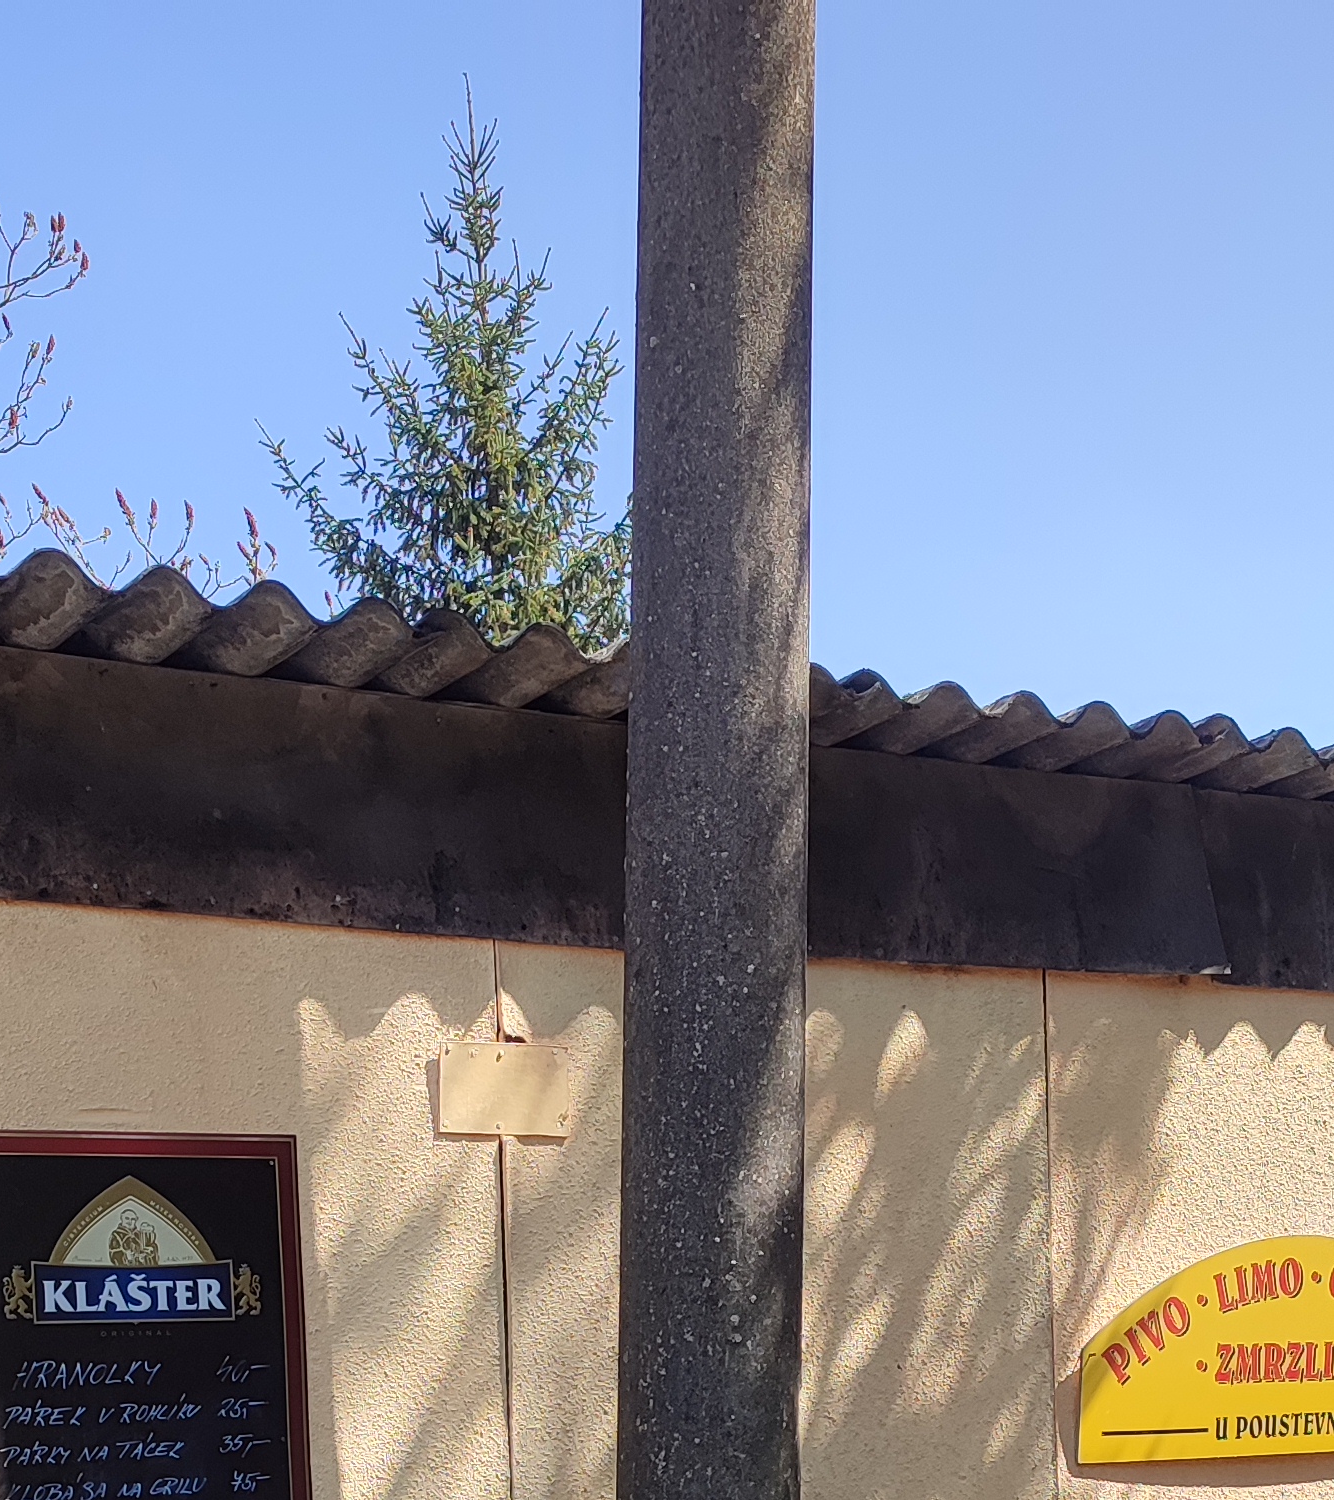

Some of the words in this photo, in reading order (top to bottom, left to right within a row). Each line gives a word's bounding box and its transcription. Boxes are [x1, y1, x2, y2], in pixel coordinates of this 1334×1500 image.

[149, 1200, 173, 1220] MATER
[42, 1273, 227, 1313] KLÁŠTER
[100, 1329, 173, 1338] ORIGINAL
[1101, 1295, 1192, 1388] PIVO
[1213, 1257, 1304, 1315] LIMO
[12, 1360, 162, 1390] HRANOLKY
[3, 1399, 87, 1429] PÁREK
[98, 1408, 115, 1424] V
[119, 1393, 202, 1424] ROHLÍKU
[1214, 1416, 1230, 1440] U
[0, 1441, 71, 1468] PÁRKY
[78, 1446, 109, 1462] NA
[117, 1485, 142, 1499] NA
[149, 1477, 207, 1495] GRILU
